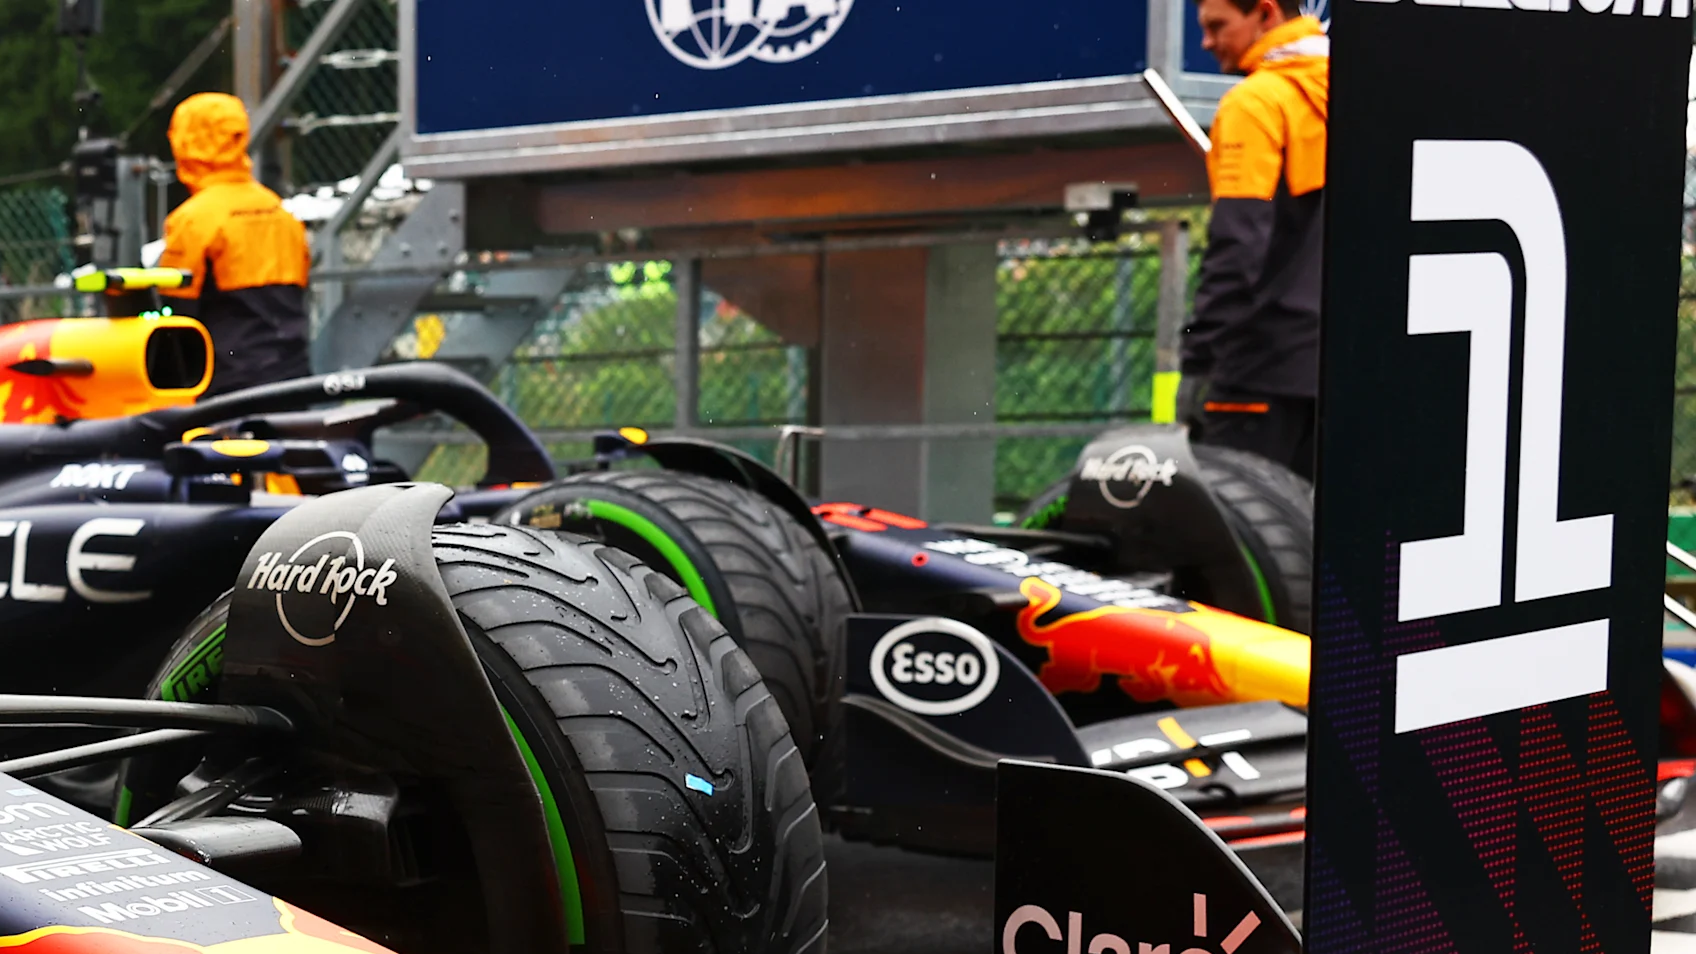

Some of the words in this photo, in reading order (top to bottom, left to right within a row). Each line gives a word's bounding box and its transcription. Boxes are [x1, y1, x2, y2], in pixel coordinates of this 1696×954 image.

[1395, 139, 1615, 734] 1
[247, 552, 330, 593] Hard
[319, 556, 398, 606] Rock
[892, 643, 979, 686] Esso
[3, 821, 103, 844] ARCTIC
[30, 833, 111, 853] WOLF
[38, 870, 211, 901] infinitum
[76, 891, 214, 924] Mobil
